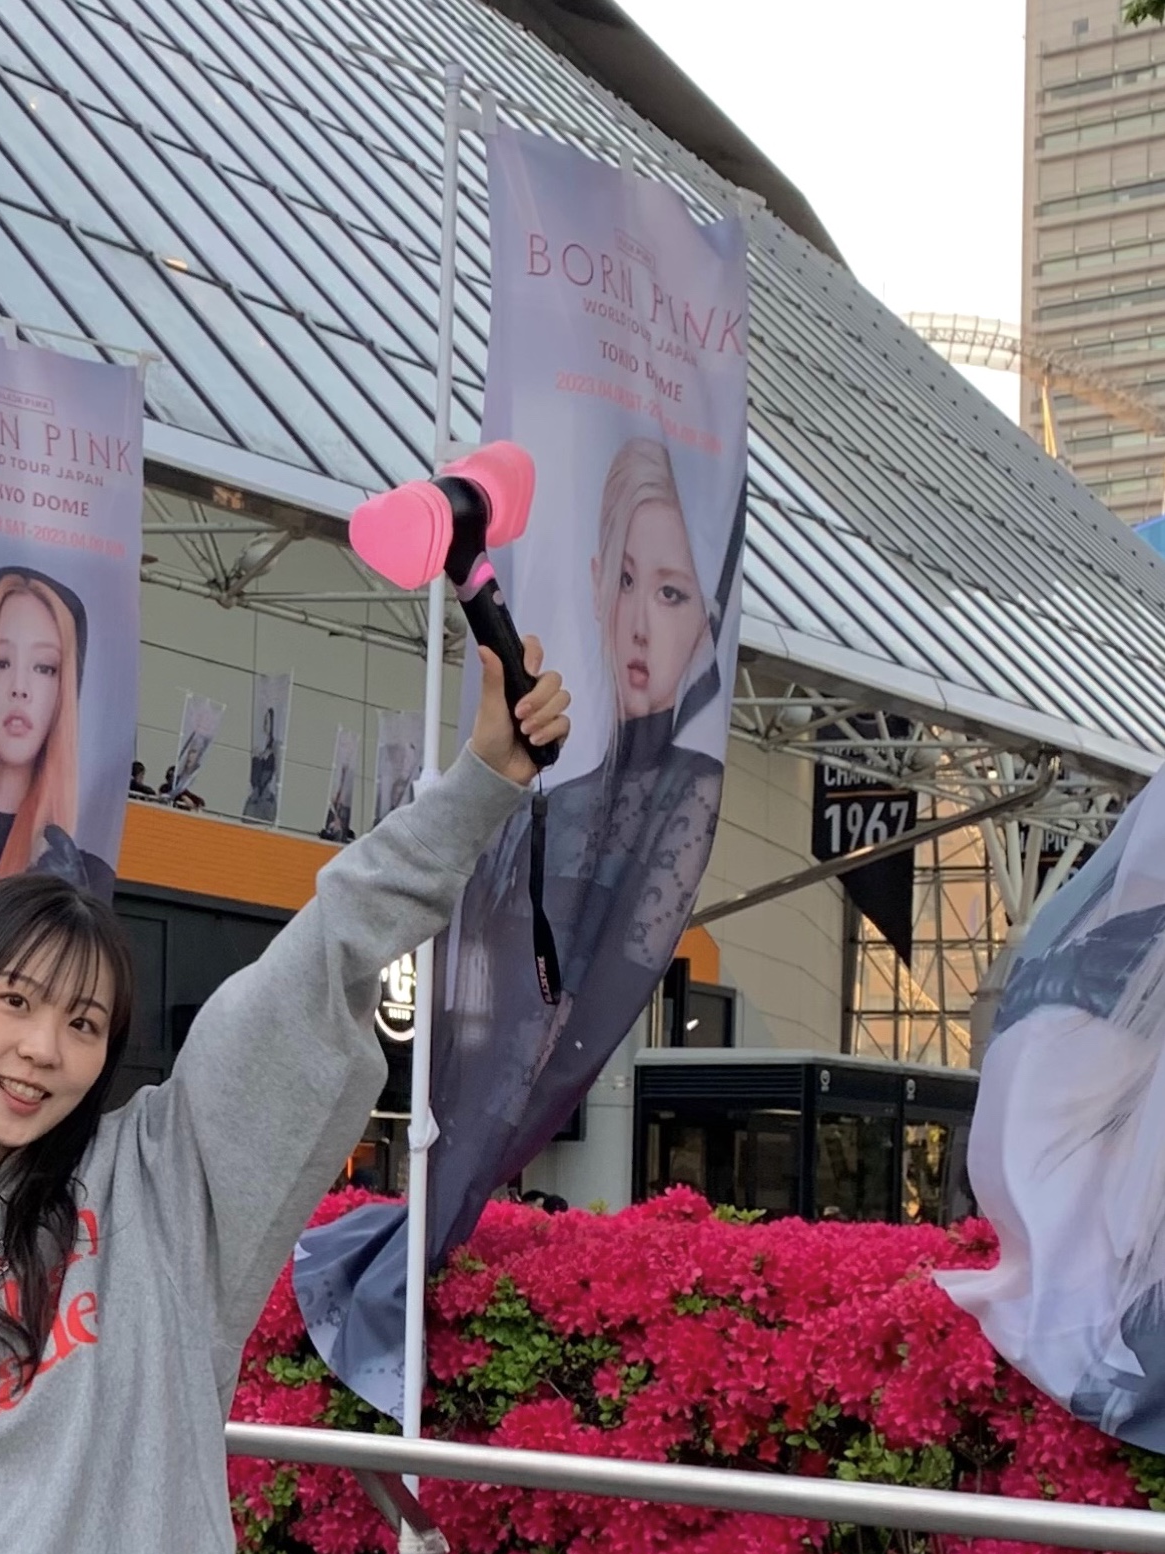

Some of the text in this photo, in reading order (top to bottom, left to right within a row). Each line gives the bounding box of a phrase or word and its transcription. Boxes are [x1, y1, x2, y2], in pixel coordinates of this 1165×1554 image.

[527, 233, 633, 310] BORN
[650, 282, 743, 356] PINK
[10, 456, 51, 476] TOUR
[56, 466, 104, 487] JAPAN
[43, 421, 133, 476] PINK
[32, 492, 89, 517] DOME
[824, 801, 909, 853] 1967
